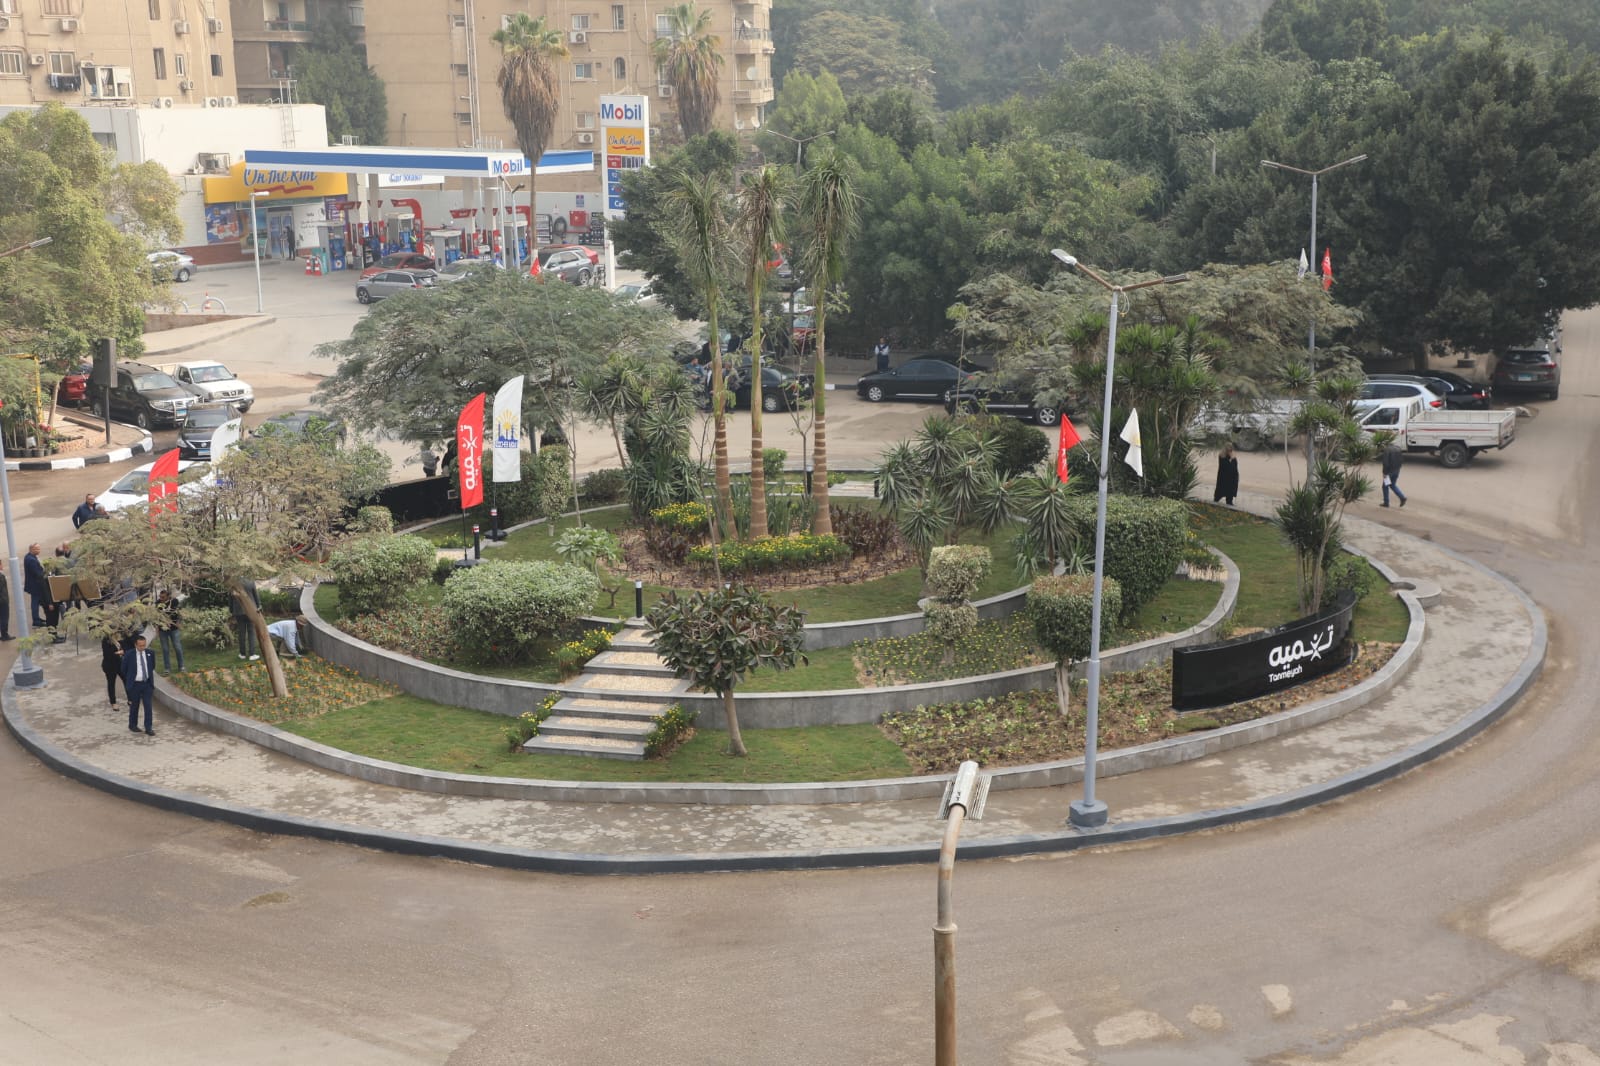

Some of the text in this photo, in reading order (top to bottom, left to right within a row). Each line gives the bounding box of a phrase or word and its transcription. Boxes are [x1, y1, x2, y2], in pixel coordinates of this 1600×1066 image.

[601, 103, 642, 120] Mobil
[493, 159, 523, 173] Mobil
[1268, 665, 1303, 683] Tanmeyah
